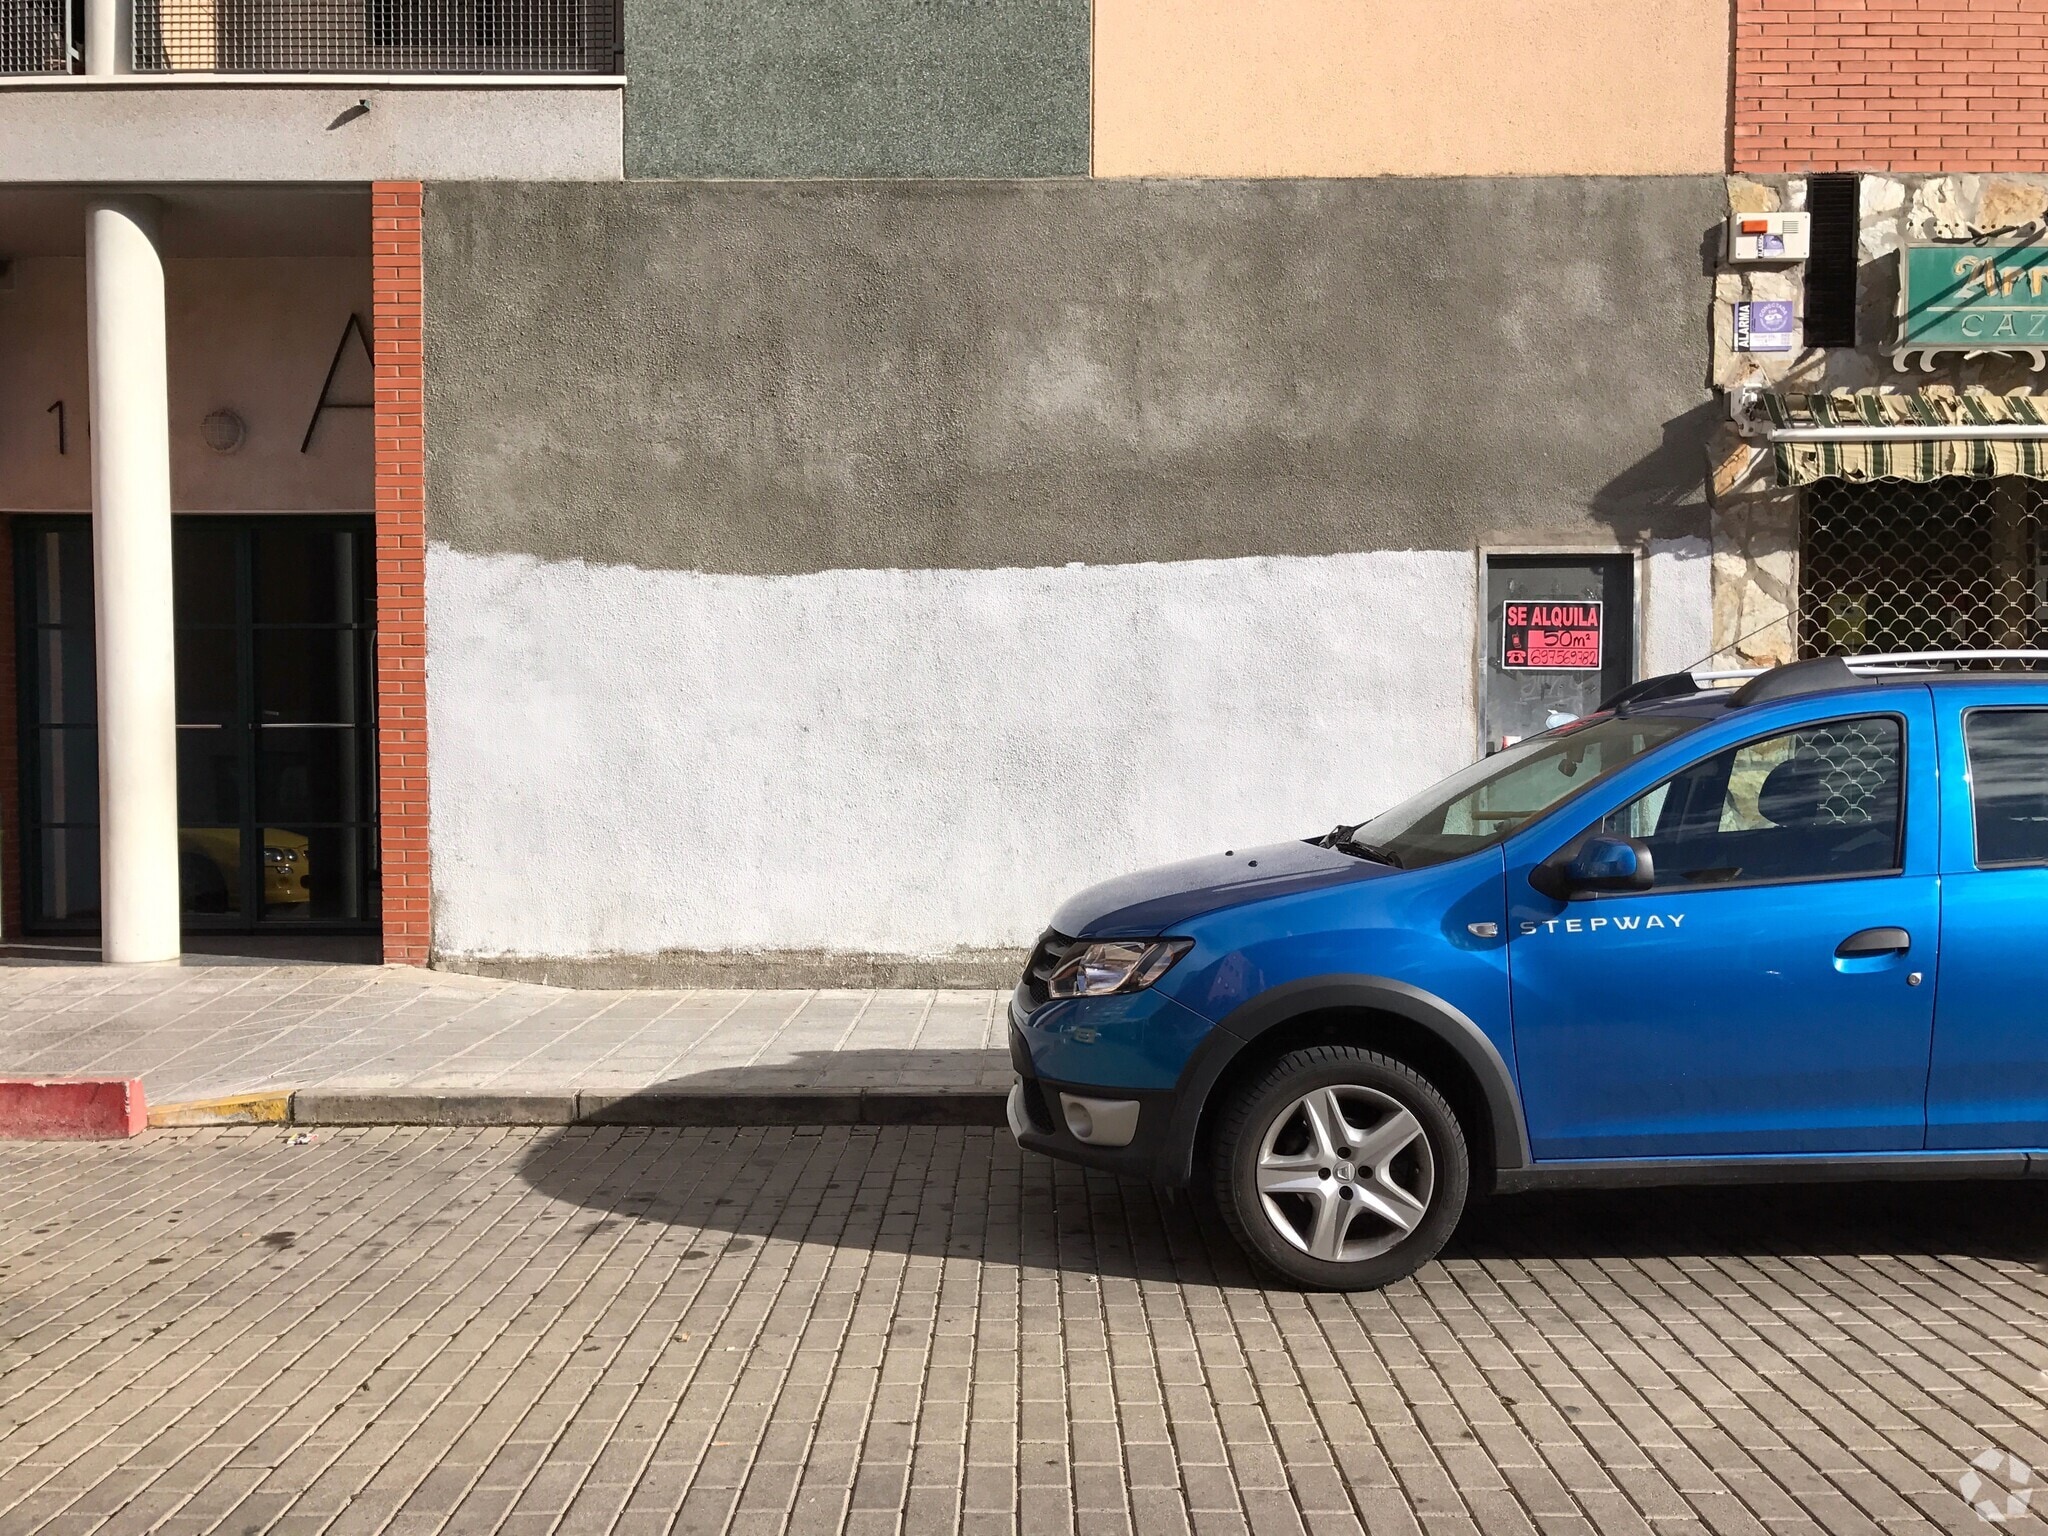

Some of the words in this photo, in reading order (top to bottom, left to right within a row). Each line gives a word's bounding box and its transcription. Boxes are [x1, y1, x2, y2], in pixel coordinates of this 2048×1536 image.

[1738, 304, 1750, 348] ALARMA
[1507, 606, 1527, 626] SE
[1531, 606, 1598, 628] ALQUILA
[1519, 913, 1686, 935] STEPWAY
